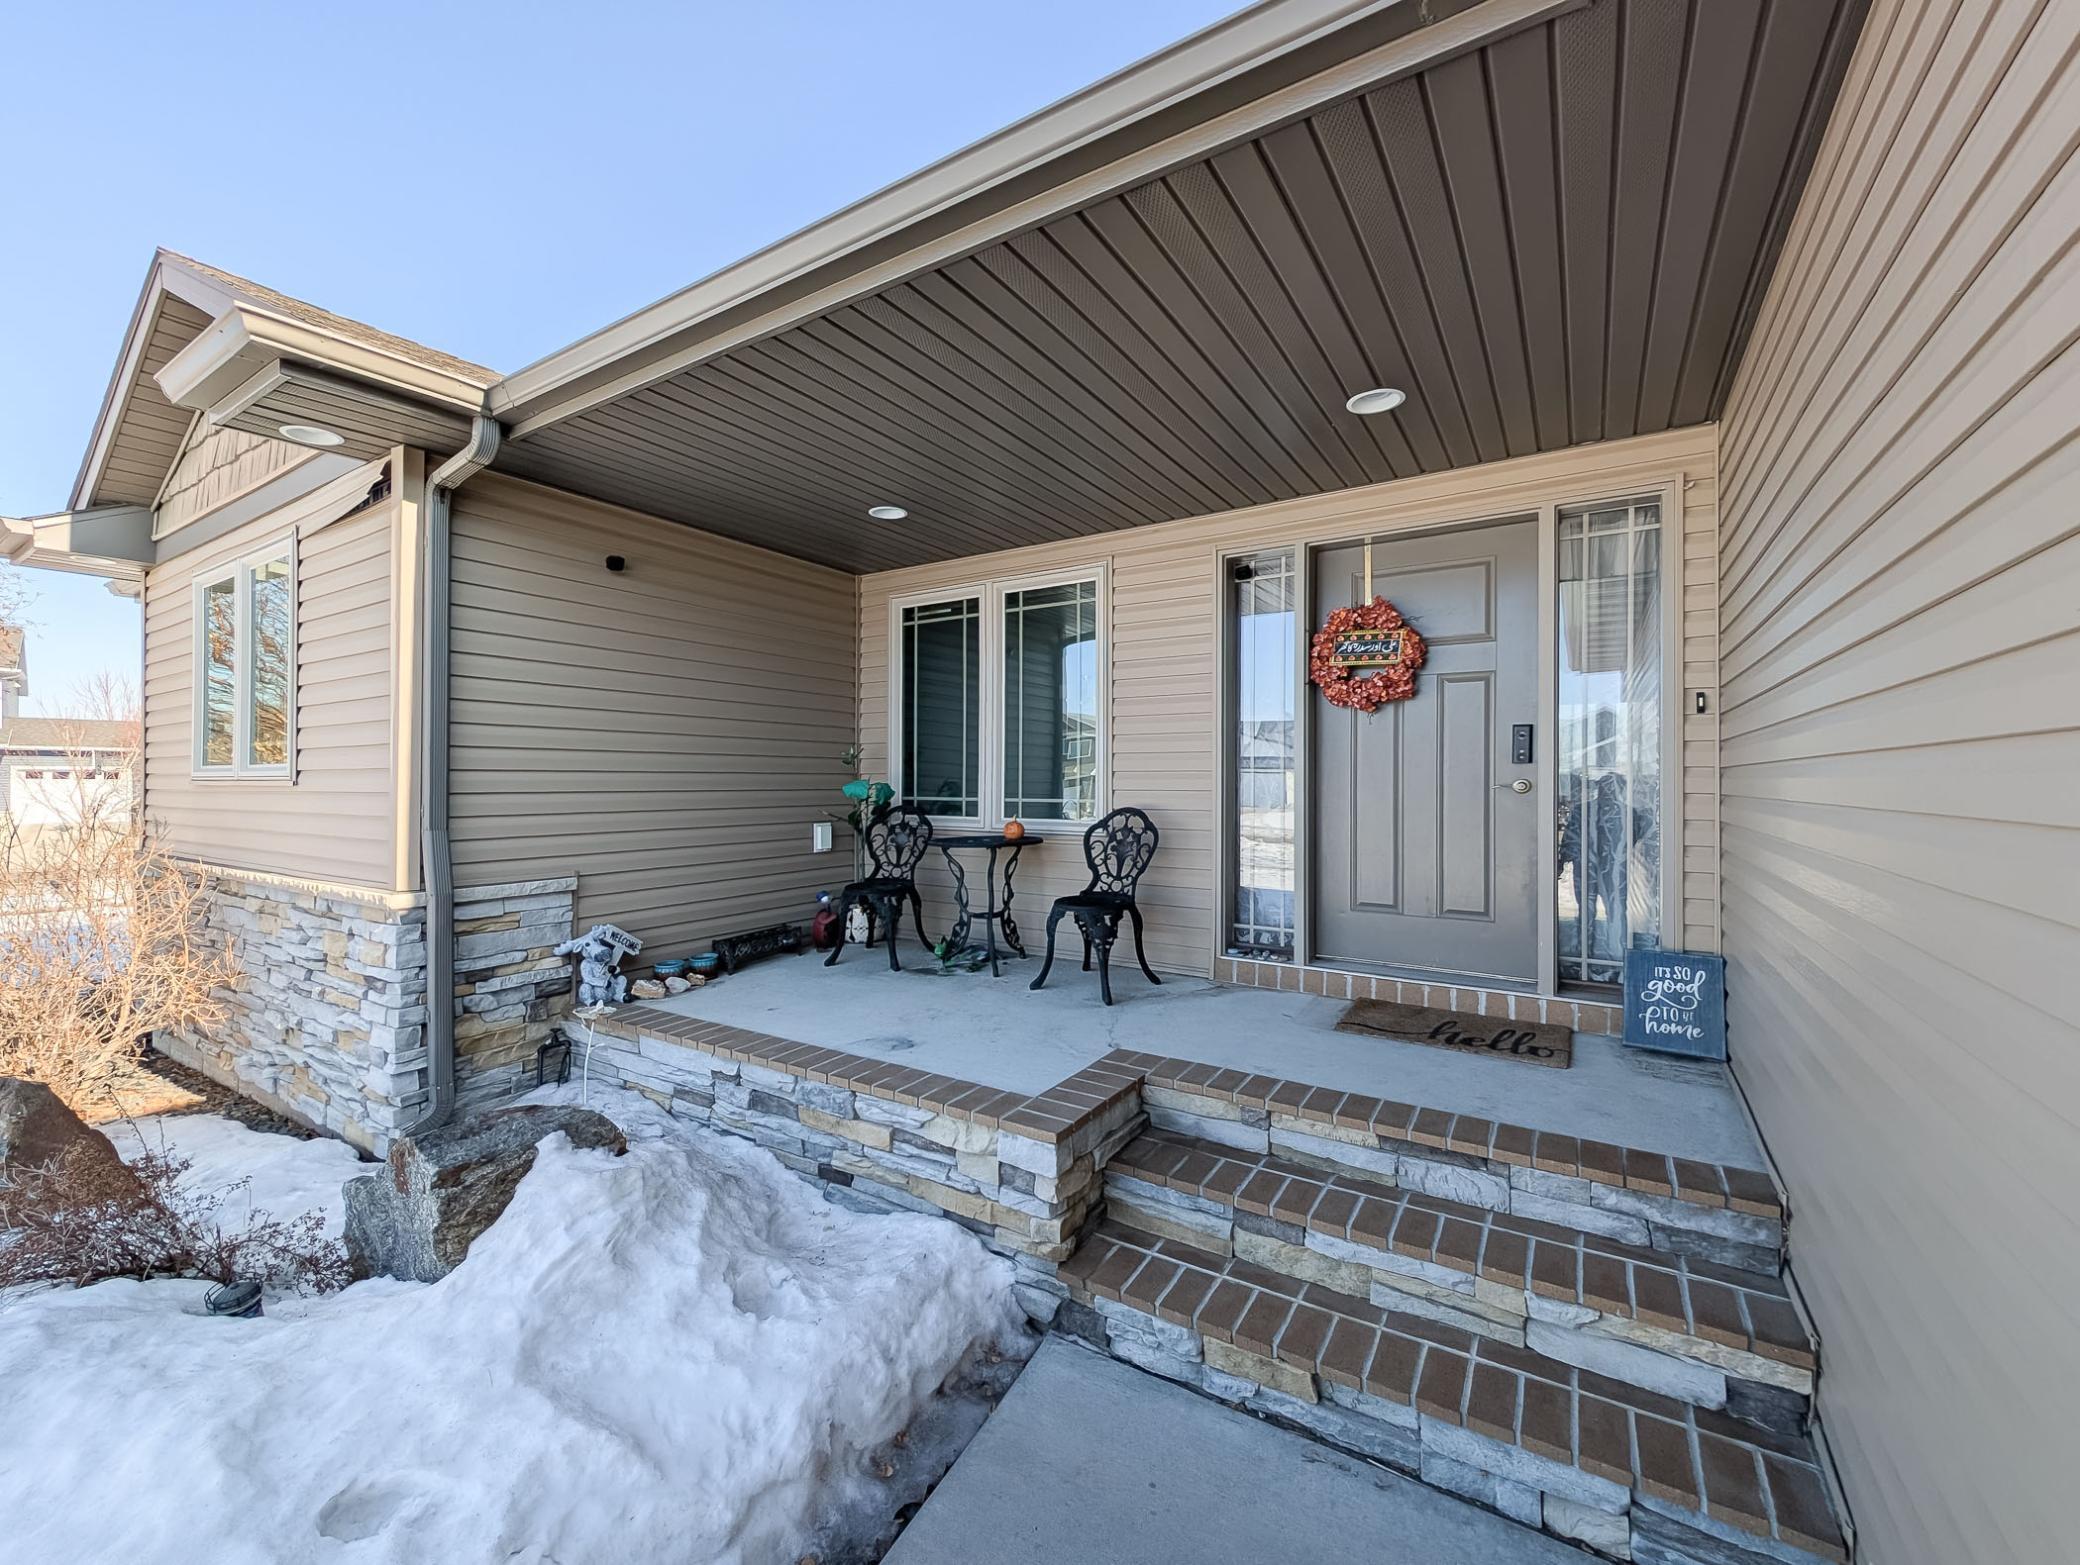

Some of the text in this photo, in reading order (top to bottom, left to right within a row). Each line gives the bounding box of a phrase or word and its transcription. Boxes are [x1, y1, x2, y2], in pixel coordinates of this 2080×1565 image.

[1368, 642, 1381, 652] اور
[1382, 640, 1397, 652] علی
[609, 931, 640, 952] WELCOME
[1672, 965, 1691, 981] SO
[1640, 970, 1706, 1010] good
[1638, 1006, 1704, 1040] home
[1661, 1006, 1679, 1022] TO
[1418, 1020, 1560, 1058] hello
